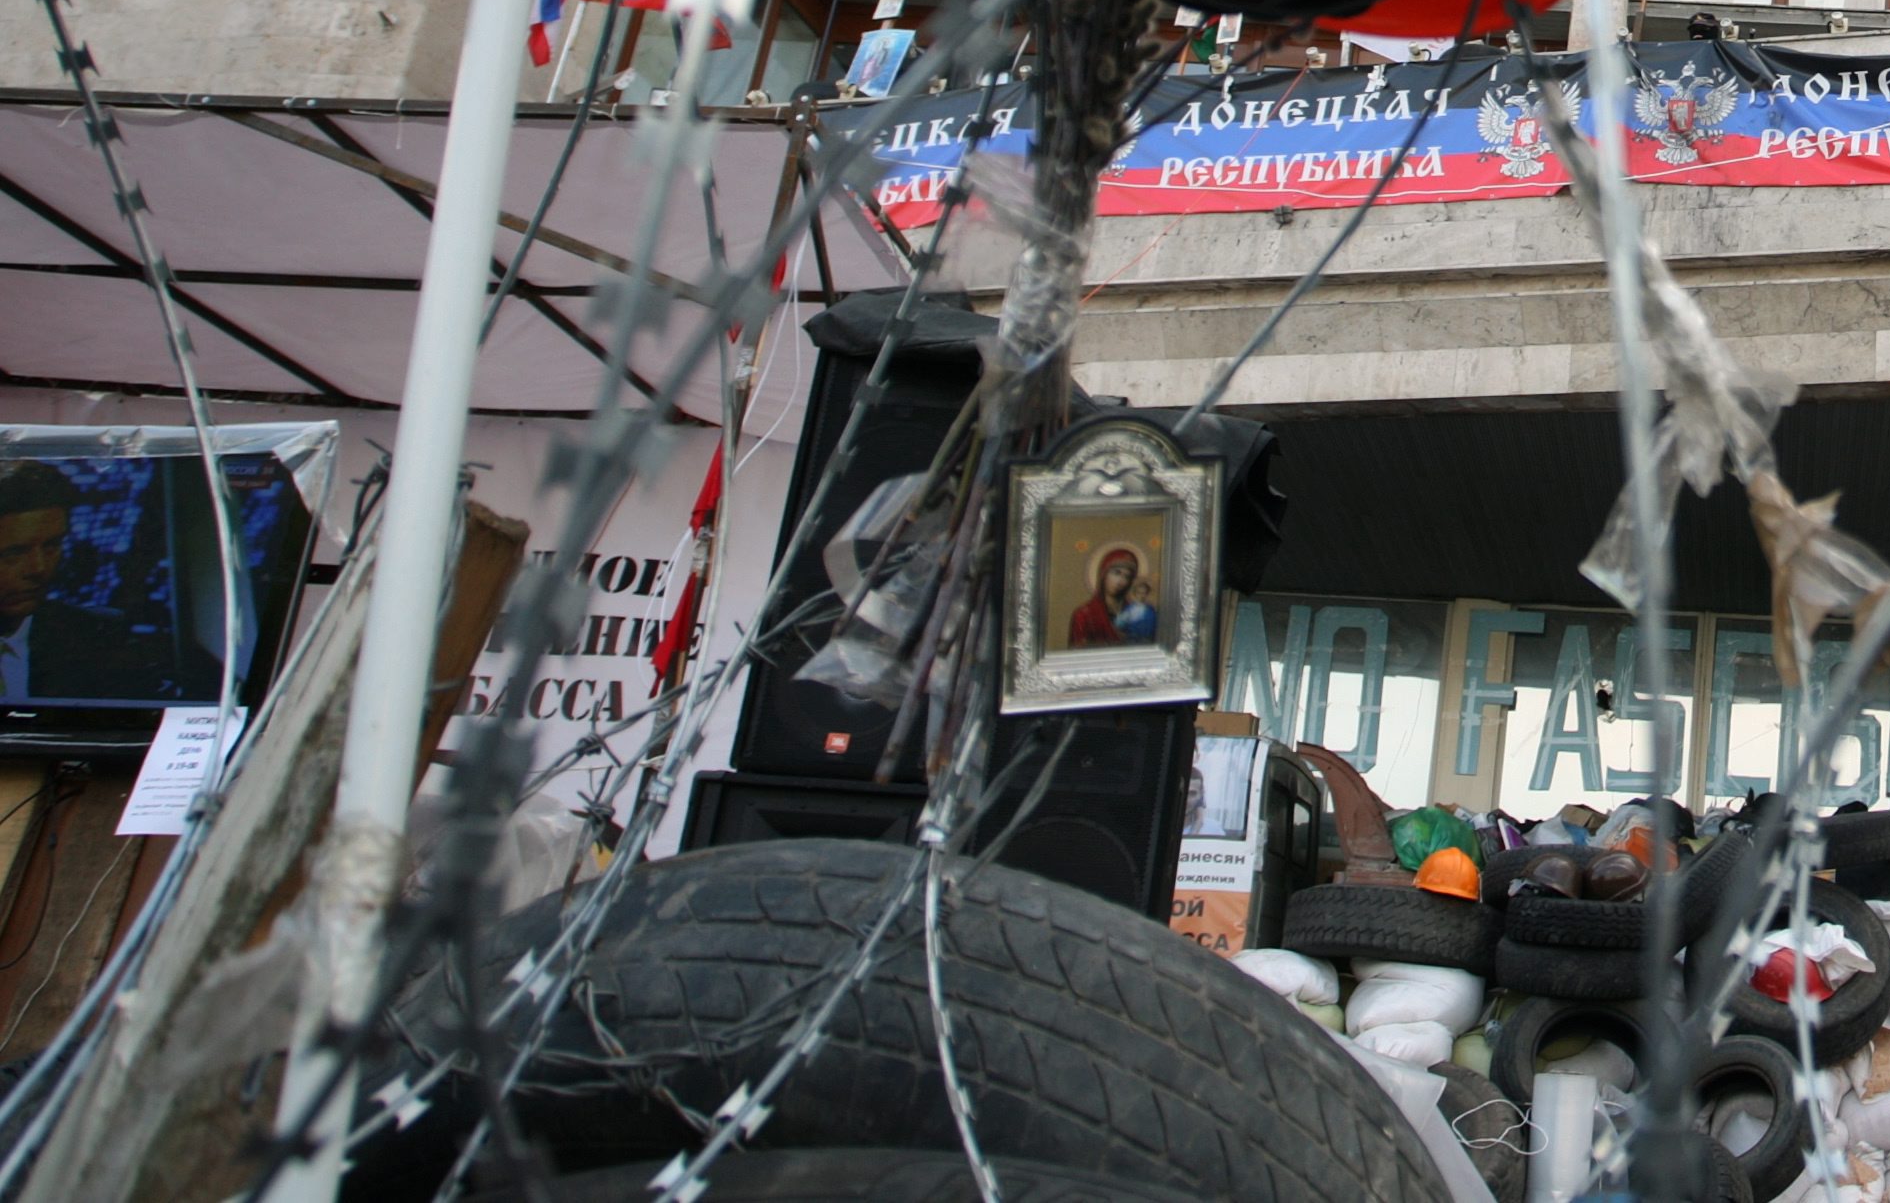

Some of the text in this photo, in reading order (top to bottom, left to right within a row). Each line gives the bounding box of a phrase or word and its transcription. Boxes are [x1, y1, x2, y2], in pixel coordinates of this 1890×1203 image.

[1173, 86, 1452, 136] ДОНЕЦКАЯ
[1159, 146, 1446, 189] РЕСПУБЛИКА
[1222, 602, 1390, 774] NO
